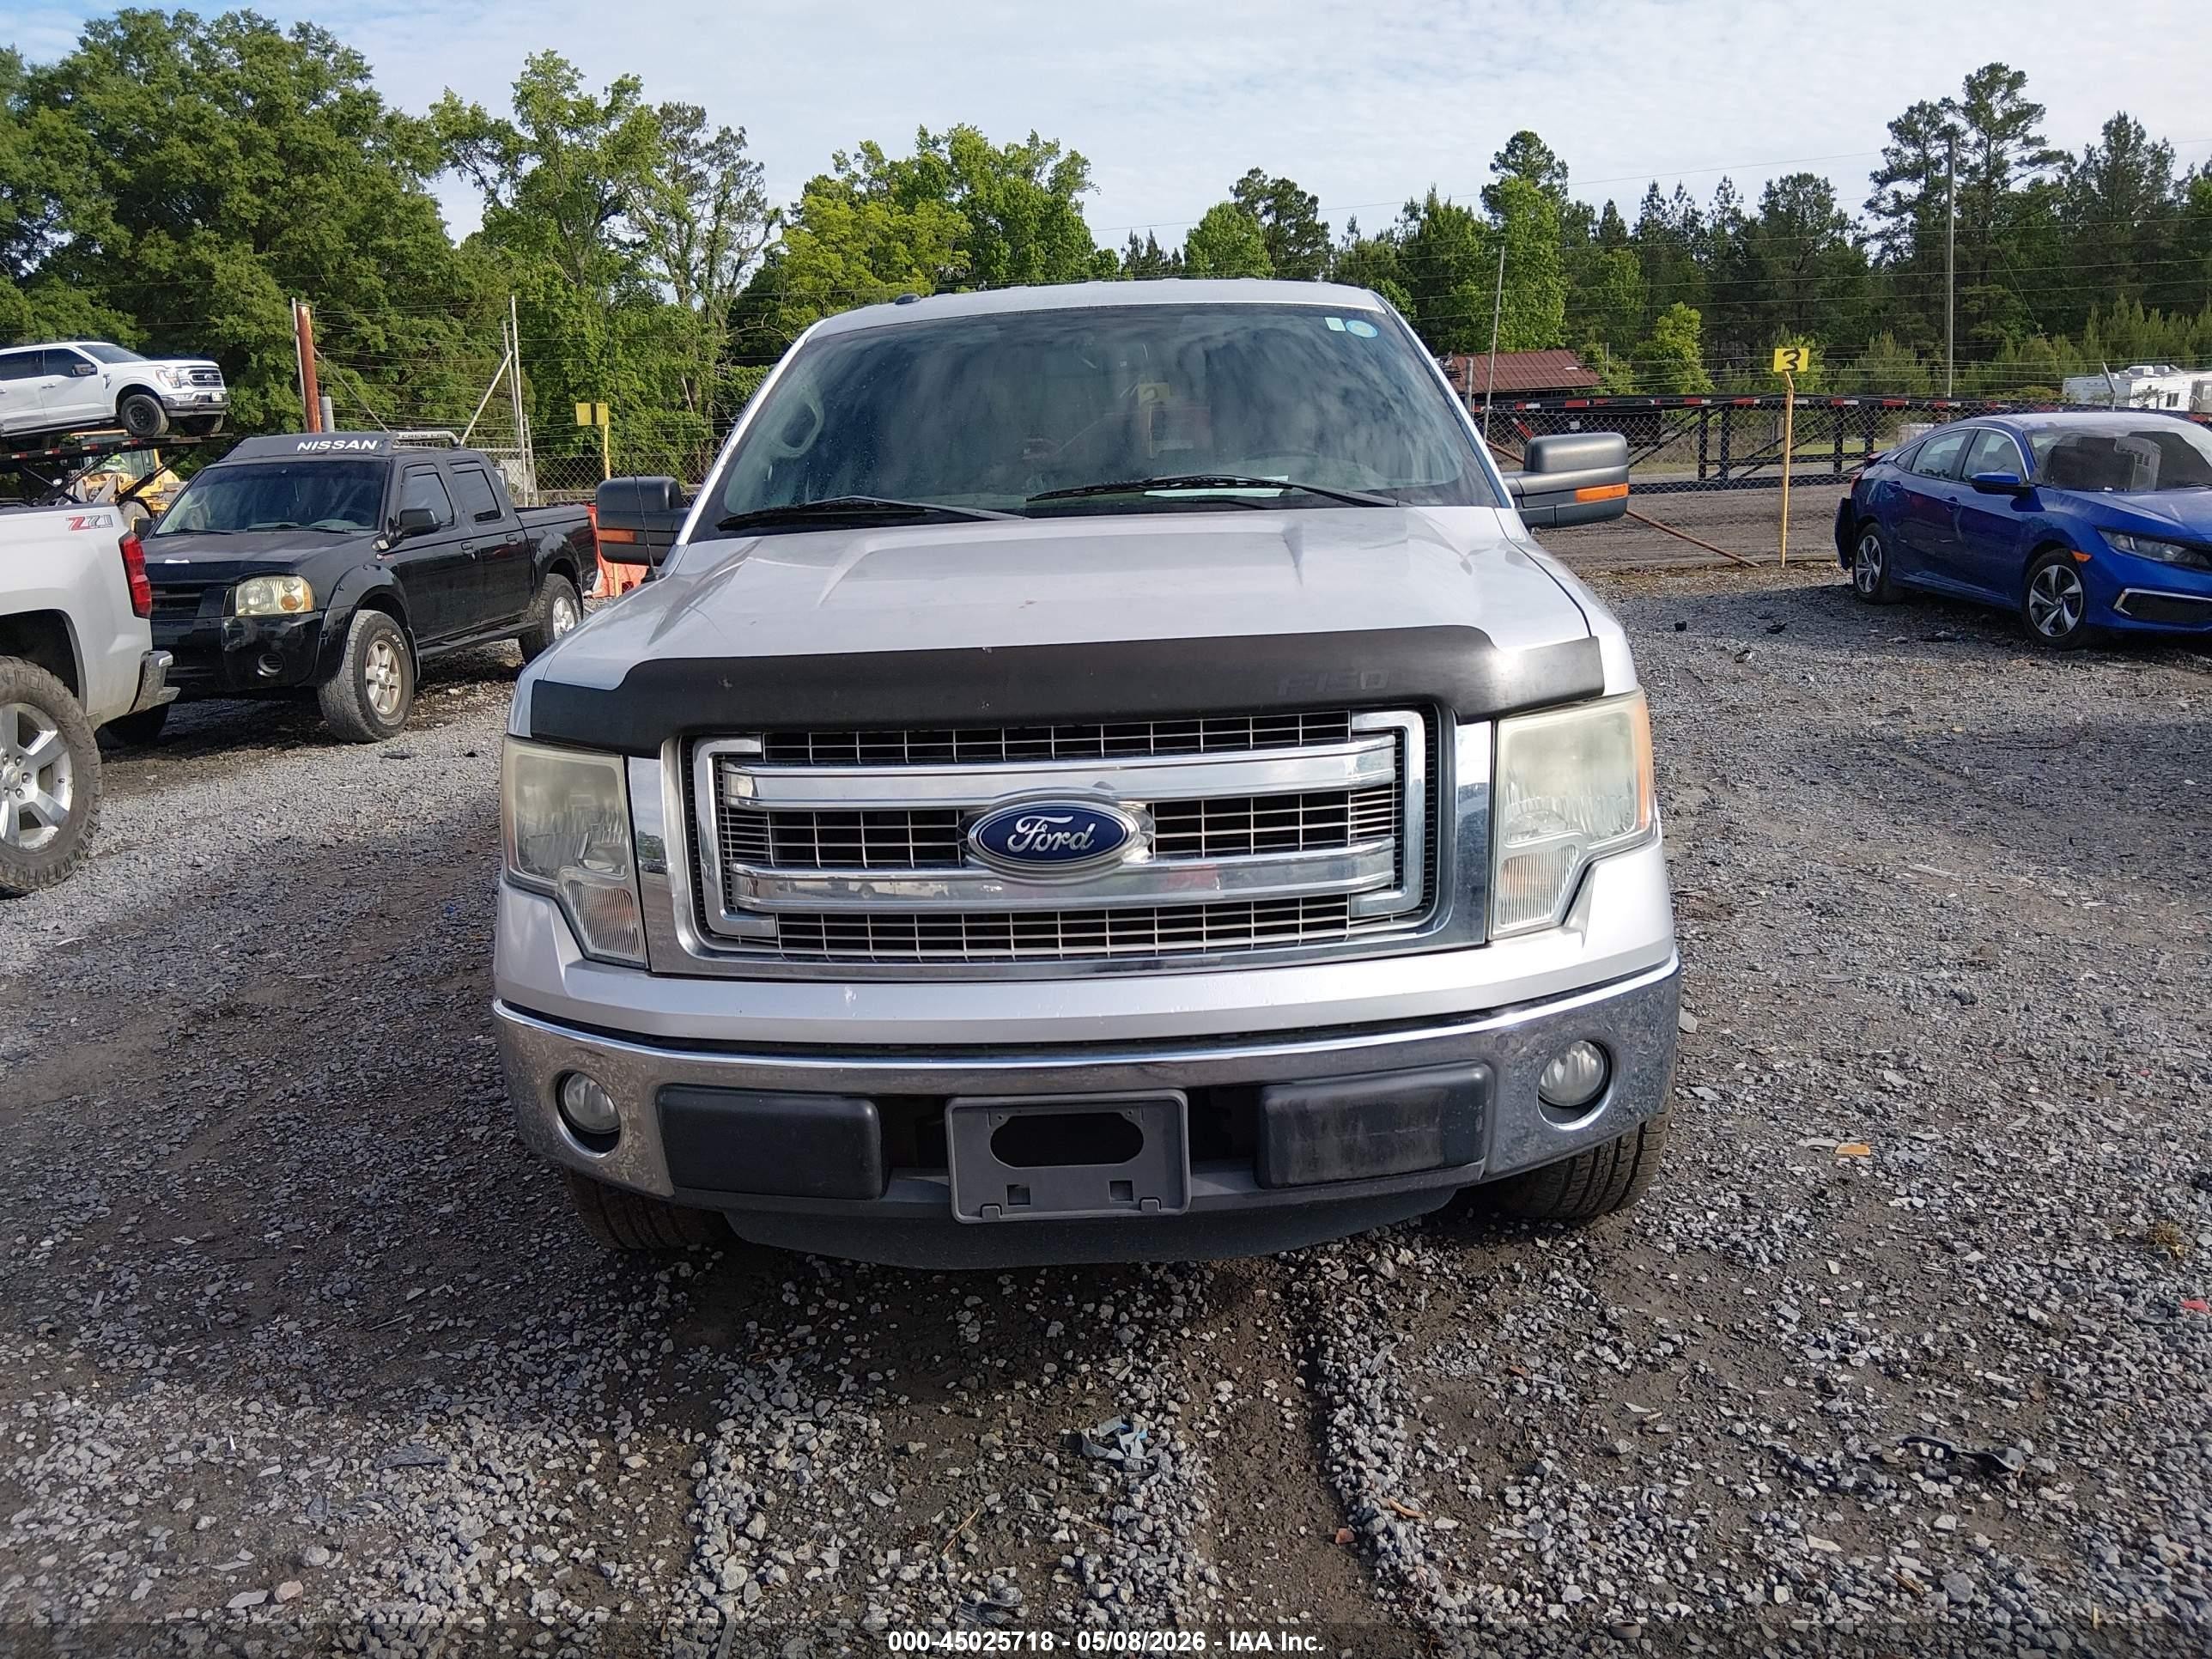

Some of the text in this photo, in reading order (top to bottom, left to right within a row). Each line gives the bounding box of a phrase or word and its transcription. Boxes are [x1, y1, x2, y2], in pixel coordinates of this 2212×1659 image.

[1782, 347, 1802, 371] 3
[296, 440, 378, 452] NISSAN
[66, 514, 113, 531] Z71
[1006, 815, 1096, 853] Ford
